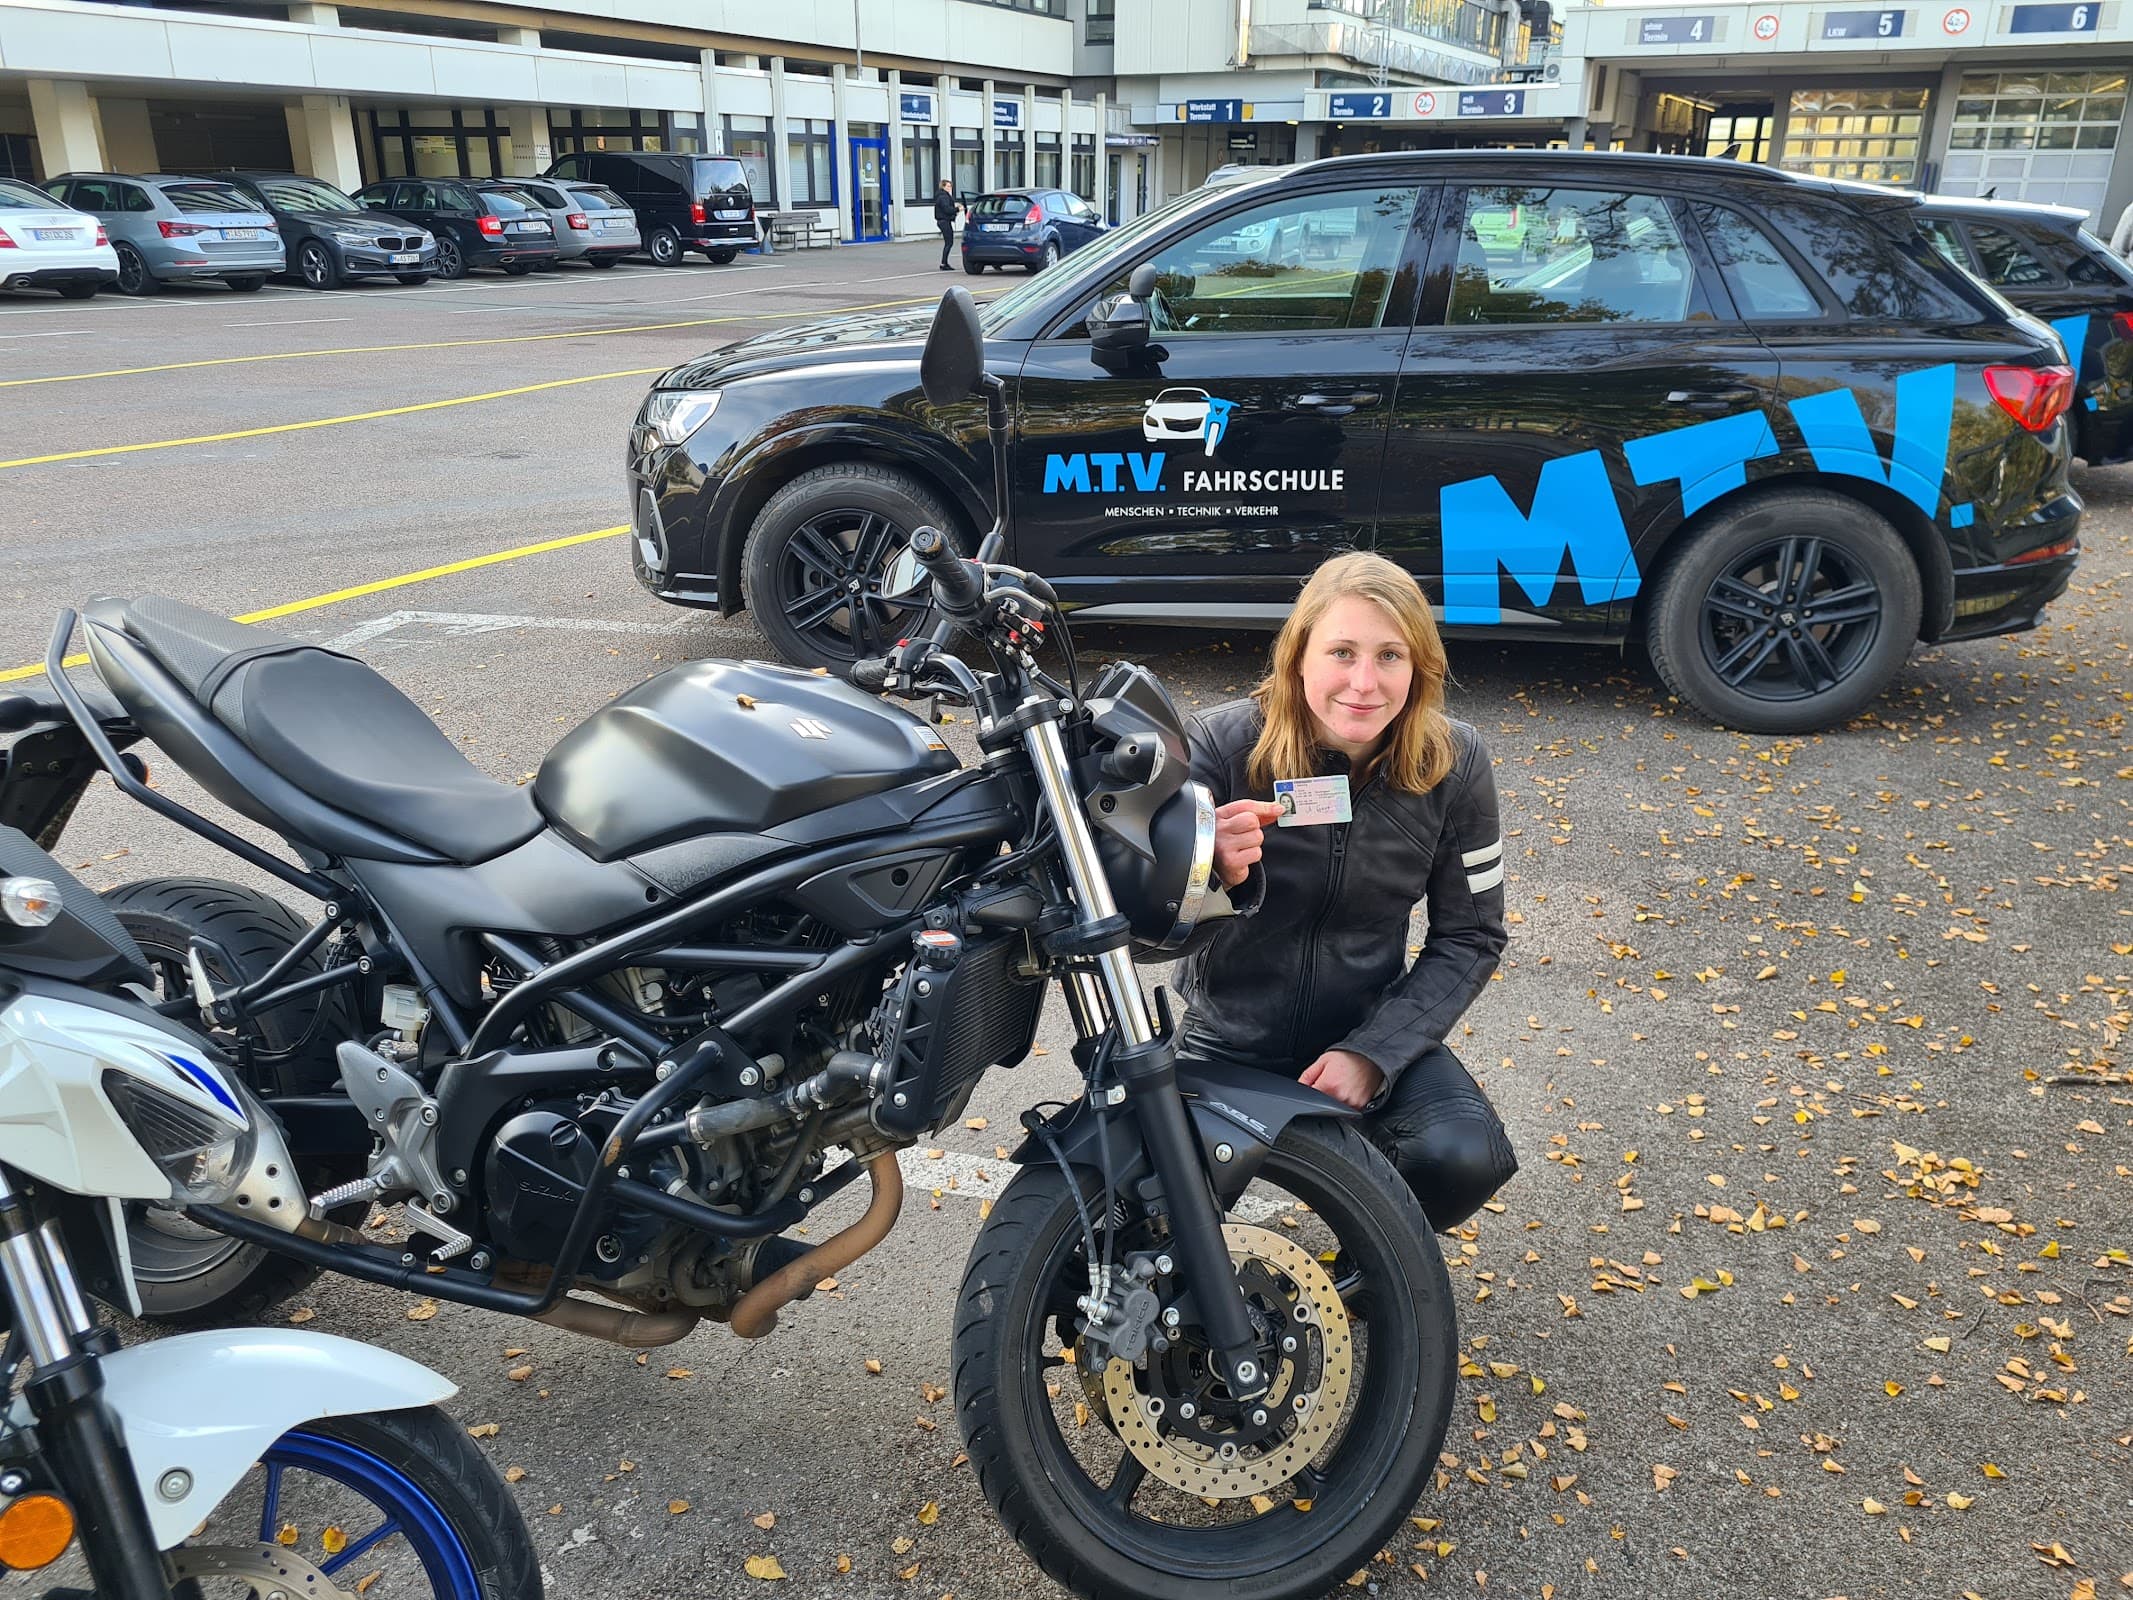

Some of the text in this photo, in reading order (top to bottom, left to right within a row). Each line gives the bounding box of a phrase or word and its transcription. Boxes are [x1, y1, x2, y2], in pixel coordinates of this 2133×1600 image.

[1878, 13, 1893, 36] 5
[2072, 5, 2088, 29] 6
[1643, 32, 1669, 42] Termin
[1690, 19, 1704, 41] 4
[1333, 97, 1345, 106] mit
[1372, 95, 1384, 116] 2
[1462, 95, 1474, 104] mit
[1503, 93, 1516, 114] 3
[1225, 101, 1234, 120] 1
[1333, 107, 1354, 116] Termin
[1462, 105, 1485, 114] Termin
[1043, 452, 1344, 493] M.T.V. FAHRSCHULE
[1105, 505, 1279, 517] MENSCHEN TECHNIK VERKEHR
